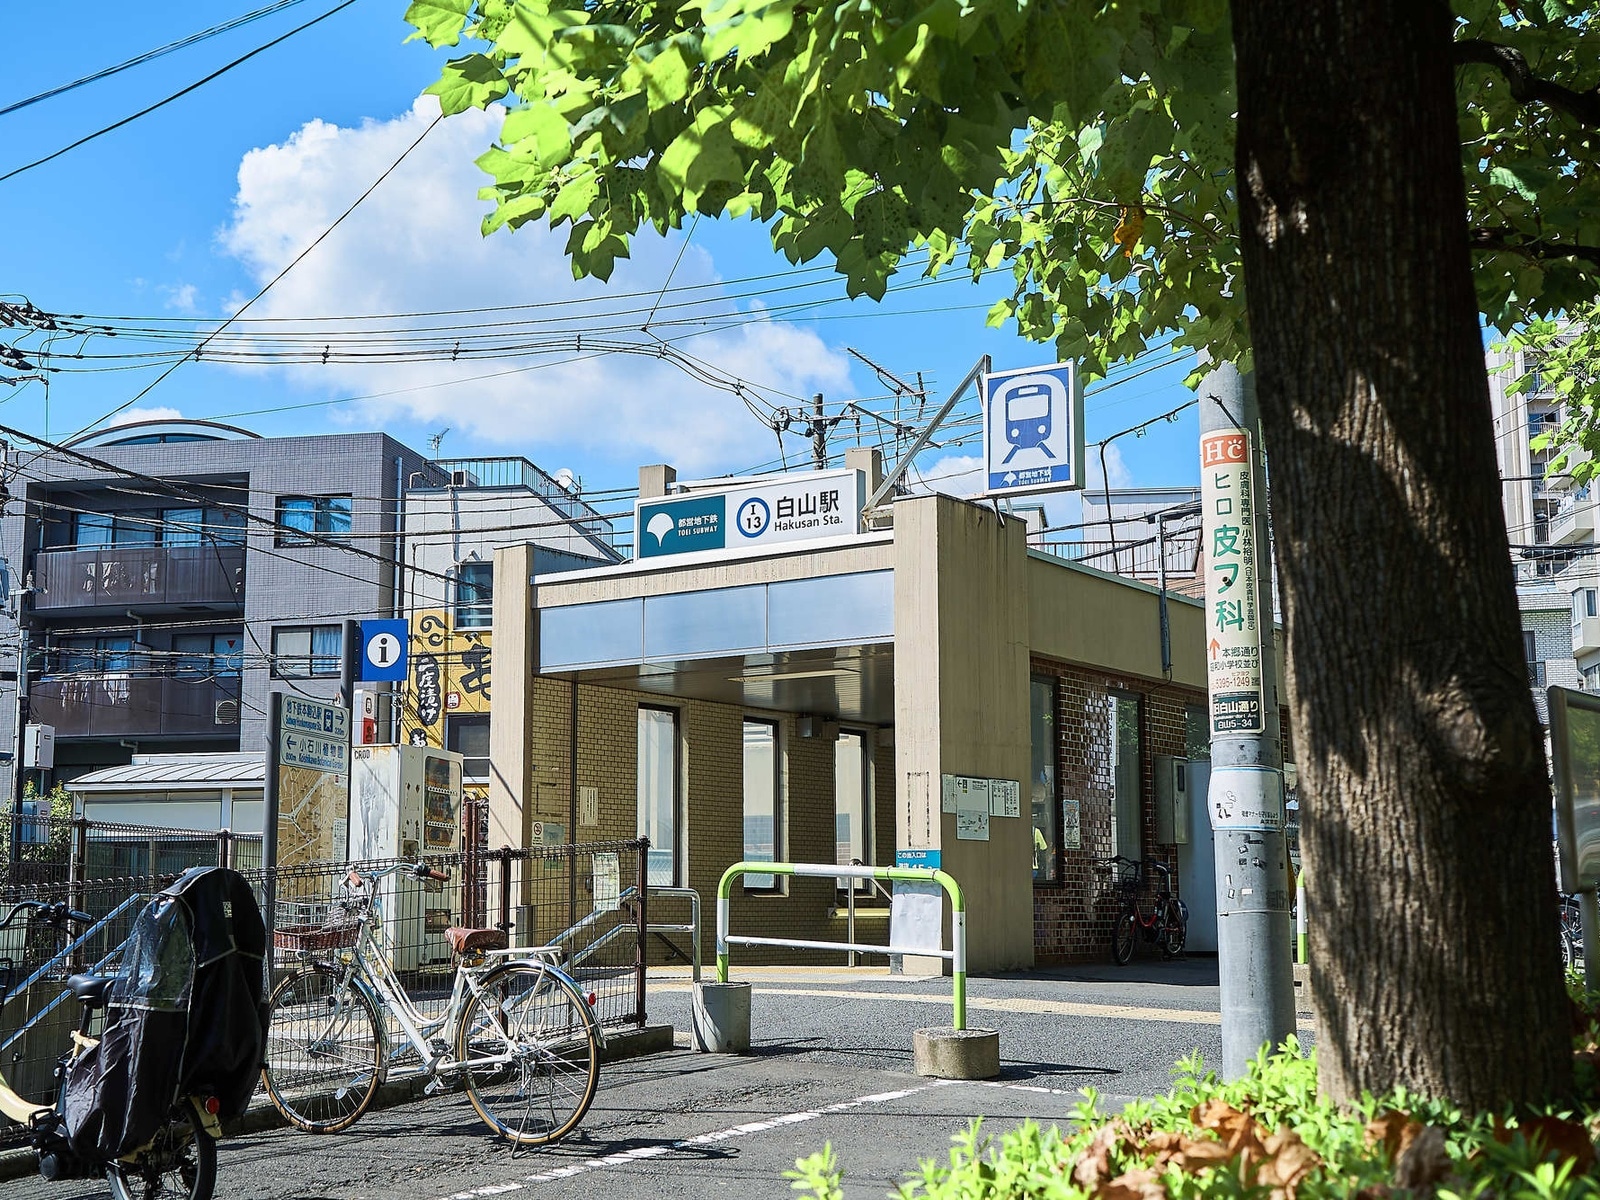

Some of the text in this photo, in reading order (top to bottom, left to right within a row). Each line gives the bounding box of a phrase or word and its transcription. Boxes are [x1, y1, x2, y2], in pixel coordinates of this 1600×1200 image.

[750, 504, 757, 515] I
[776, 489, 840, 519] 白山駅
[678, 514, 719, 528] 都営地下鉄
[746, 516, 761, 530] 13
[774, 514, 843, 533] Hakusan Sta.
[678, 525, 718, 537] TOEI SUBWAY
[1222, 646, 1258, 659] 本郷通り
[418, 658, 439, 722] 二度漬け
[300, 739, 344, 759] 小石川植物園
